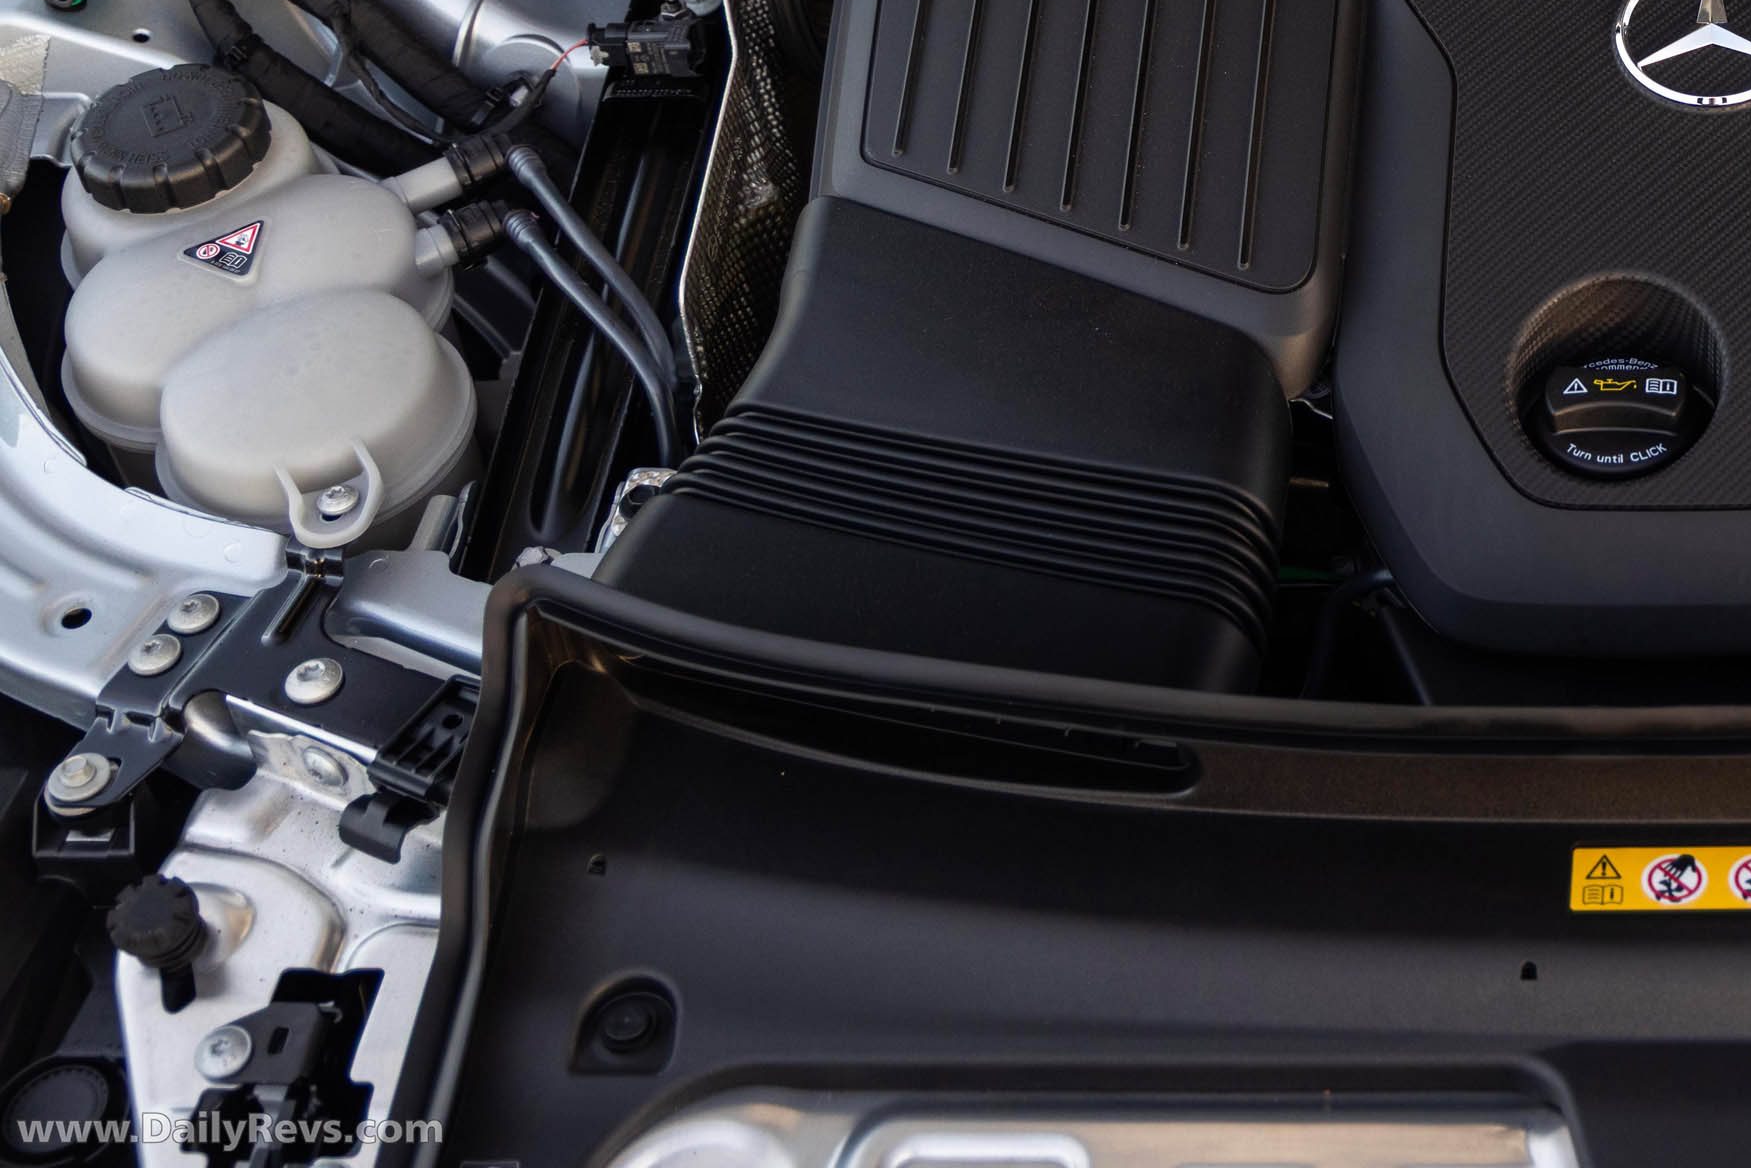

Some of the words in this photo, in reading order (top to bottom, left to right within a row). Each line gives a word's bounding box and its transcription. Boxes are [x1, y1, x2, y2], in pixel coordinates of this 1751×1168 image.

[1583, 357, 1659, 369] rcedes-Benz
[1566, 442, 1593, 461] Turn
[1596, 452, 1624, 464] until
[1629, 442, 1668, 462] CLICK
